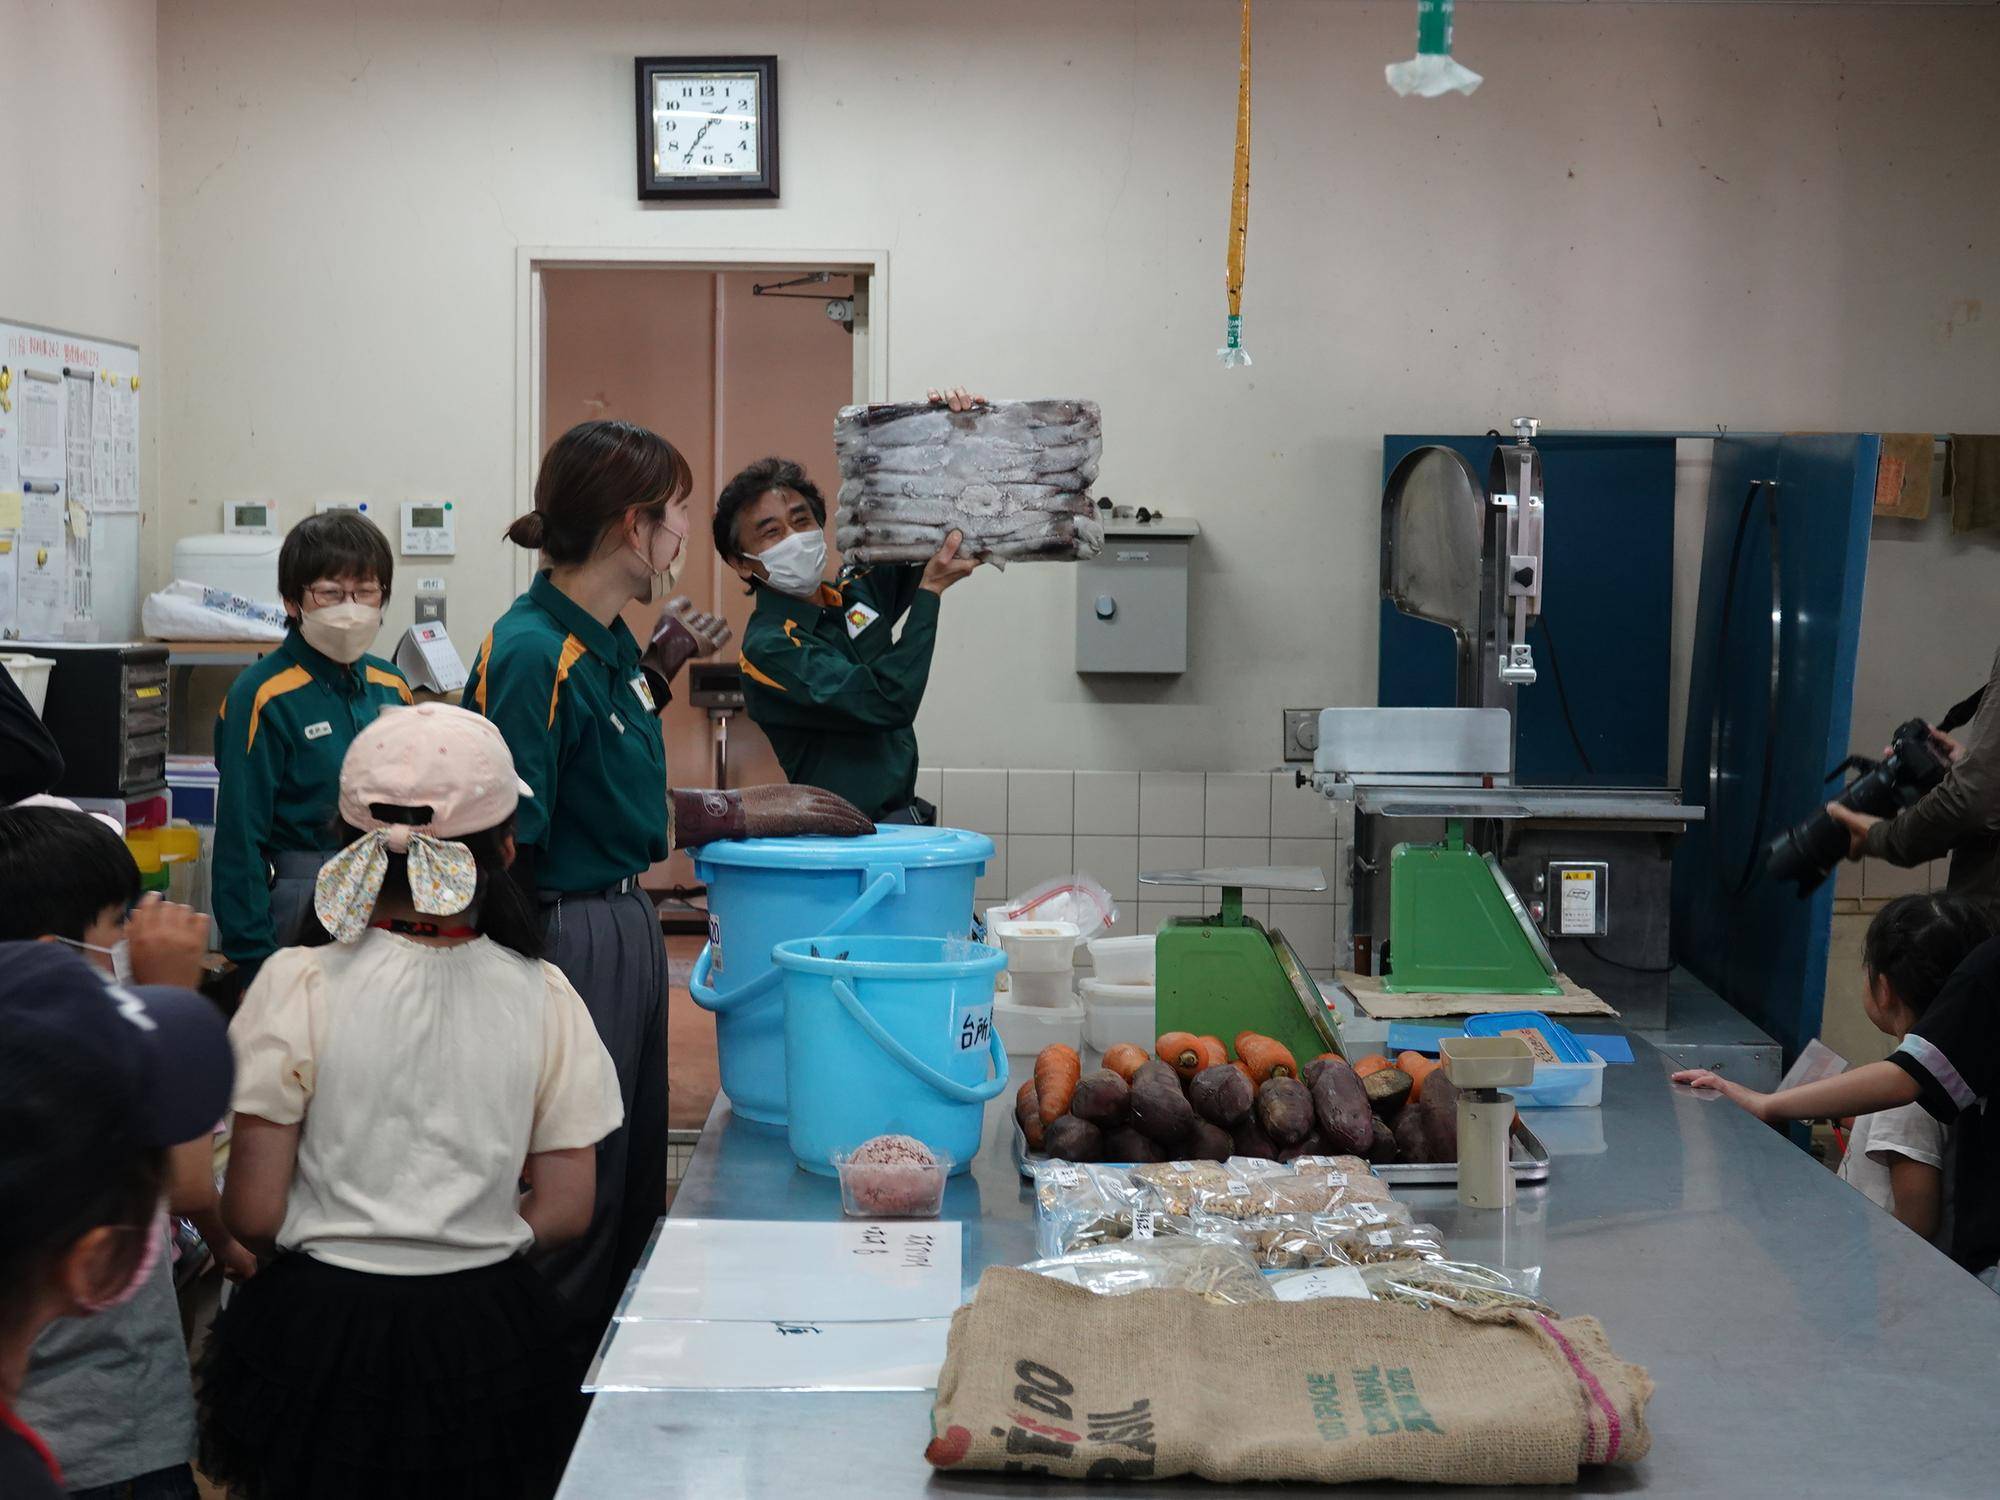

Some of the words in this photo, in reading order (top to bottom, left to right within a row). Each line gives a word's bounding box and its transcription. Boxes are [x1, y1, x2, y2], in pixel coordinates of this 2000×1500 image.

[682, 87, 692, 97] 11
[700, 85, 715, 97] 12
[725, 87, 730, 97] 1
[666, 100, 680, 111] 10
[738, 99, 748, 110] 2
[666, 120, 676, 131] 9
[739, 120, 749, 131] 3
[668, 141, 679, 152] 8
[738, 140, 748, 150] 4
[682, 153, 693, 164] 7
[702, 154, 713, 165] 6
[723, 153, 733, 164] 5
[961, 1006, 994, 1050] 台所
